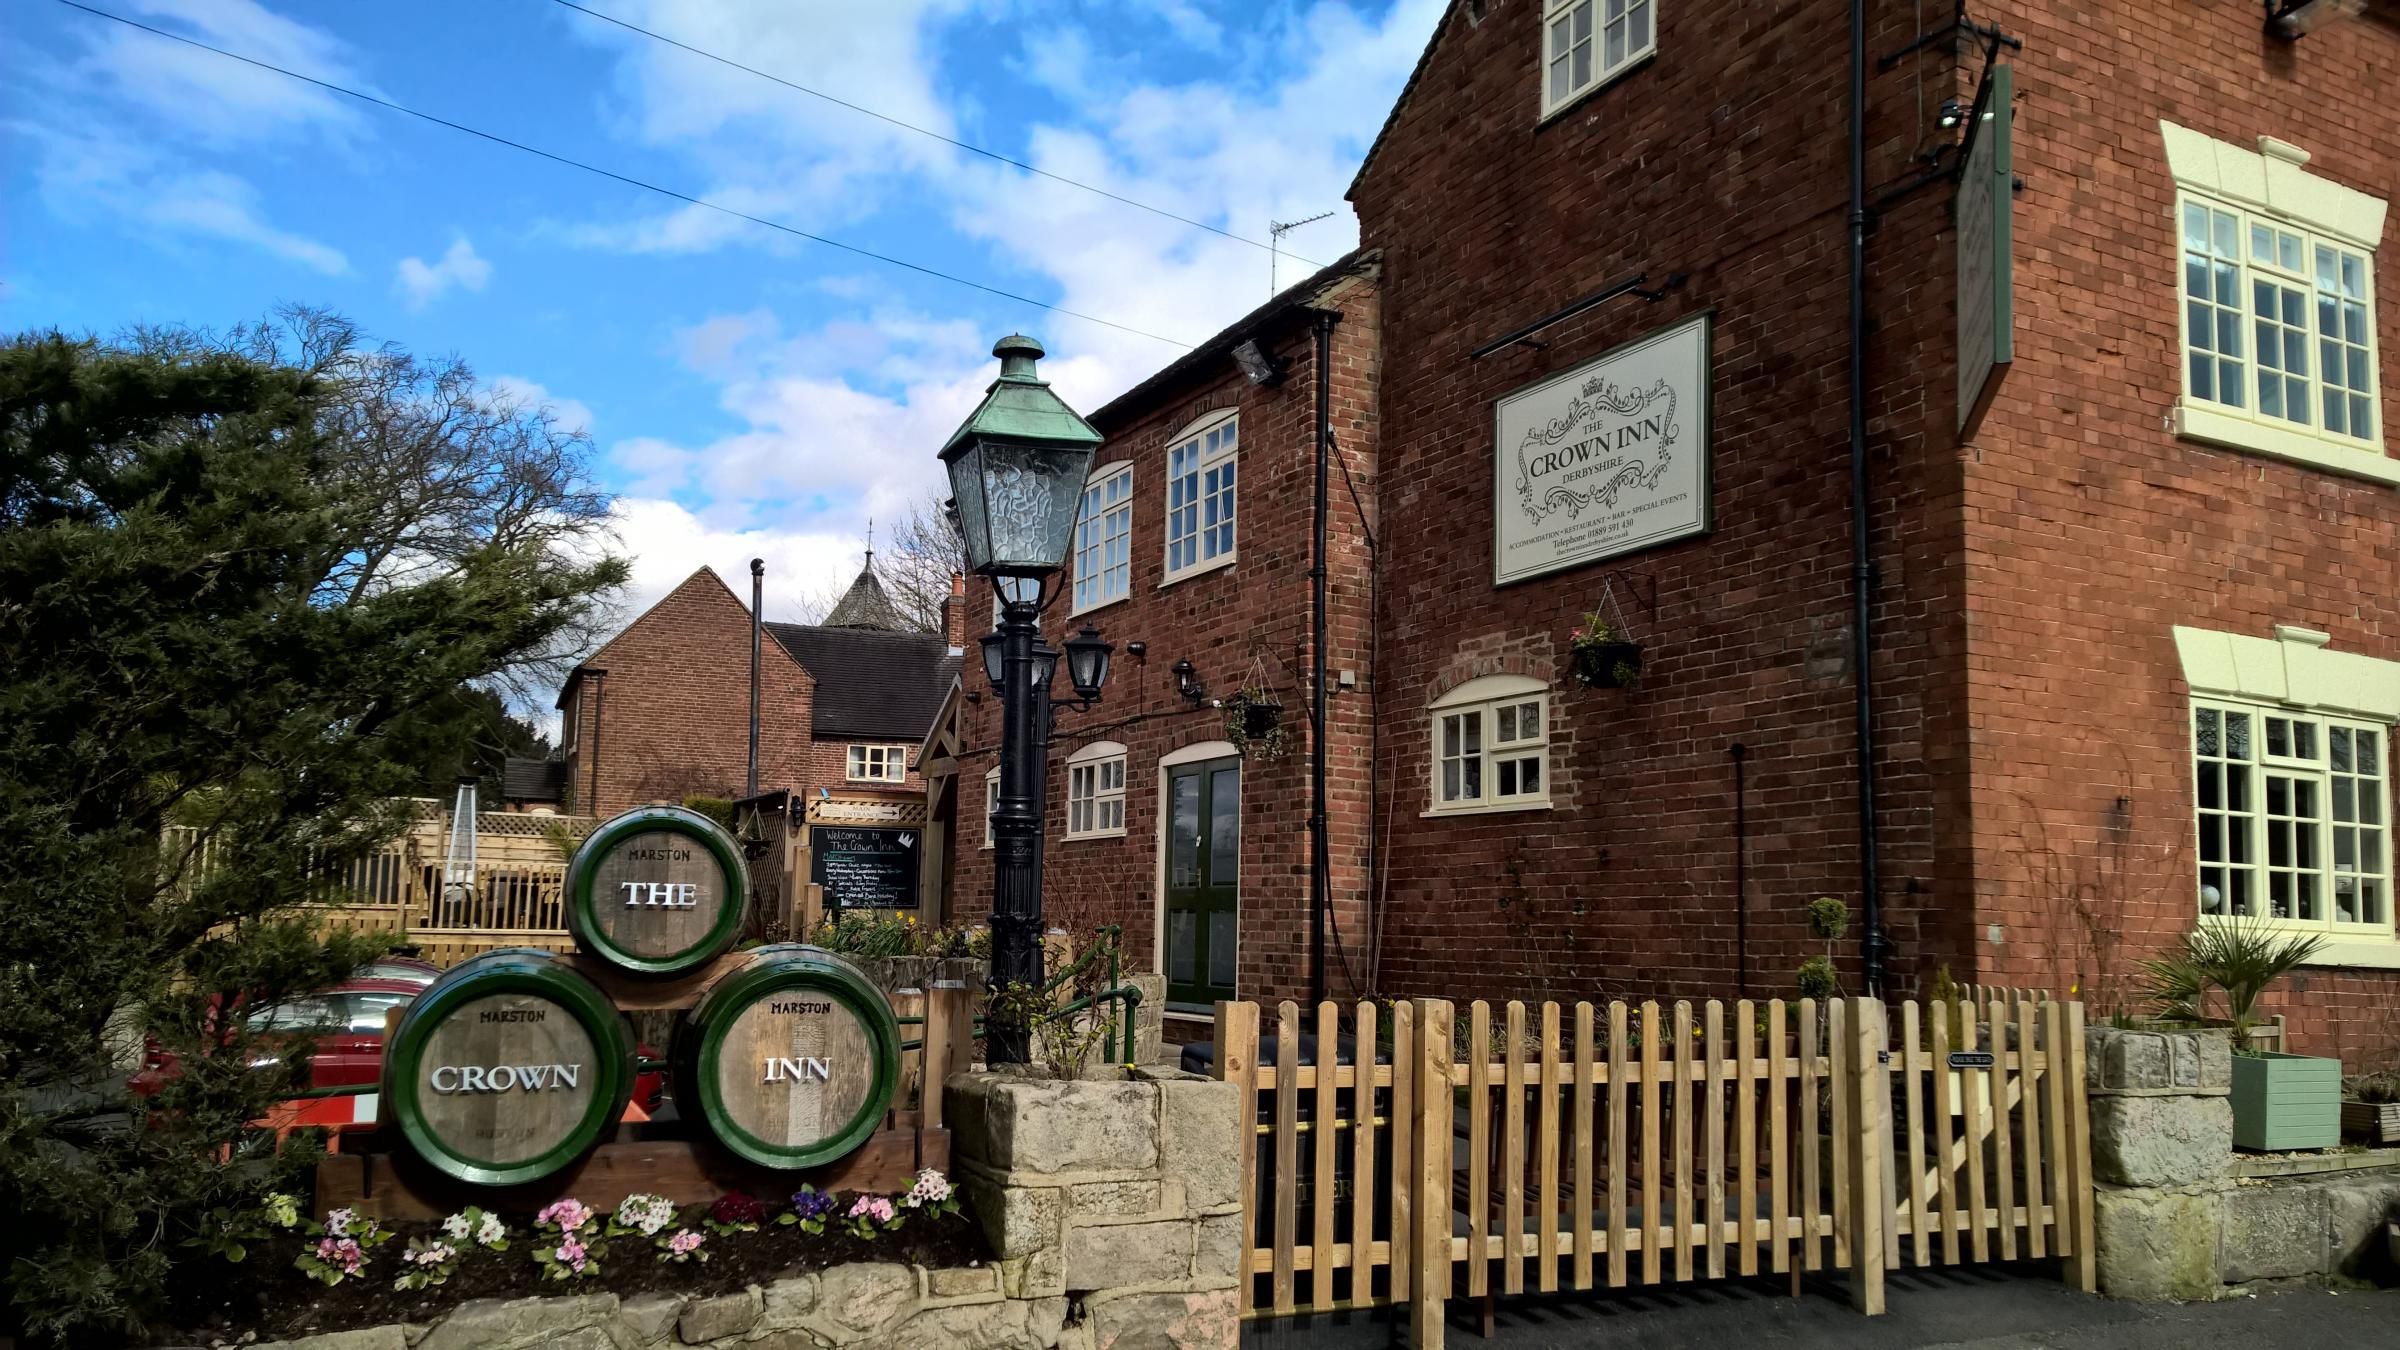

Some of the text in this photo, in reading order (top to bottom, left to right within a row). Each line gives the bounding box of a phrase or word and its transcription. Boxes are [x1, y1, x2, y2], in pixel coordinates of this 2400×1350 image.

[1583, 420, 1603, 435] THE
[1530, 415, 1662, 478] CROWN INN
[1562, 456, 1625, 484] DERBYSHIRE
[1508, 492, 1688, 550] ACCOMMODATION RESTAURANT BAR SPECIAL EVENTS
[1553, 533, 1586, 550] Telephone
[826, 830, 880, 840] Welcome to
[830, 841, 847, 850] The
[629, 849, 690, 862] MARSTON
[620, 881, 697, 906] THE
[480, 1010, 546, 1023] MARSTON
[770, 1002, 832, 1015] MARSTON
[764, 1057, 832, 1081] INN
[431, 1064, 582, 1092] CROWN
